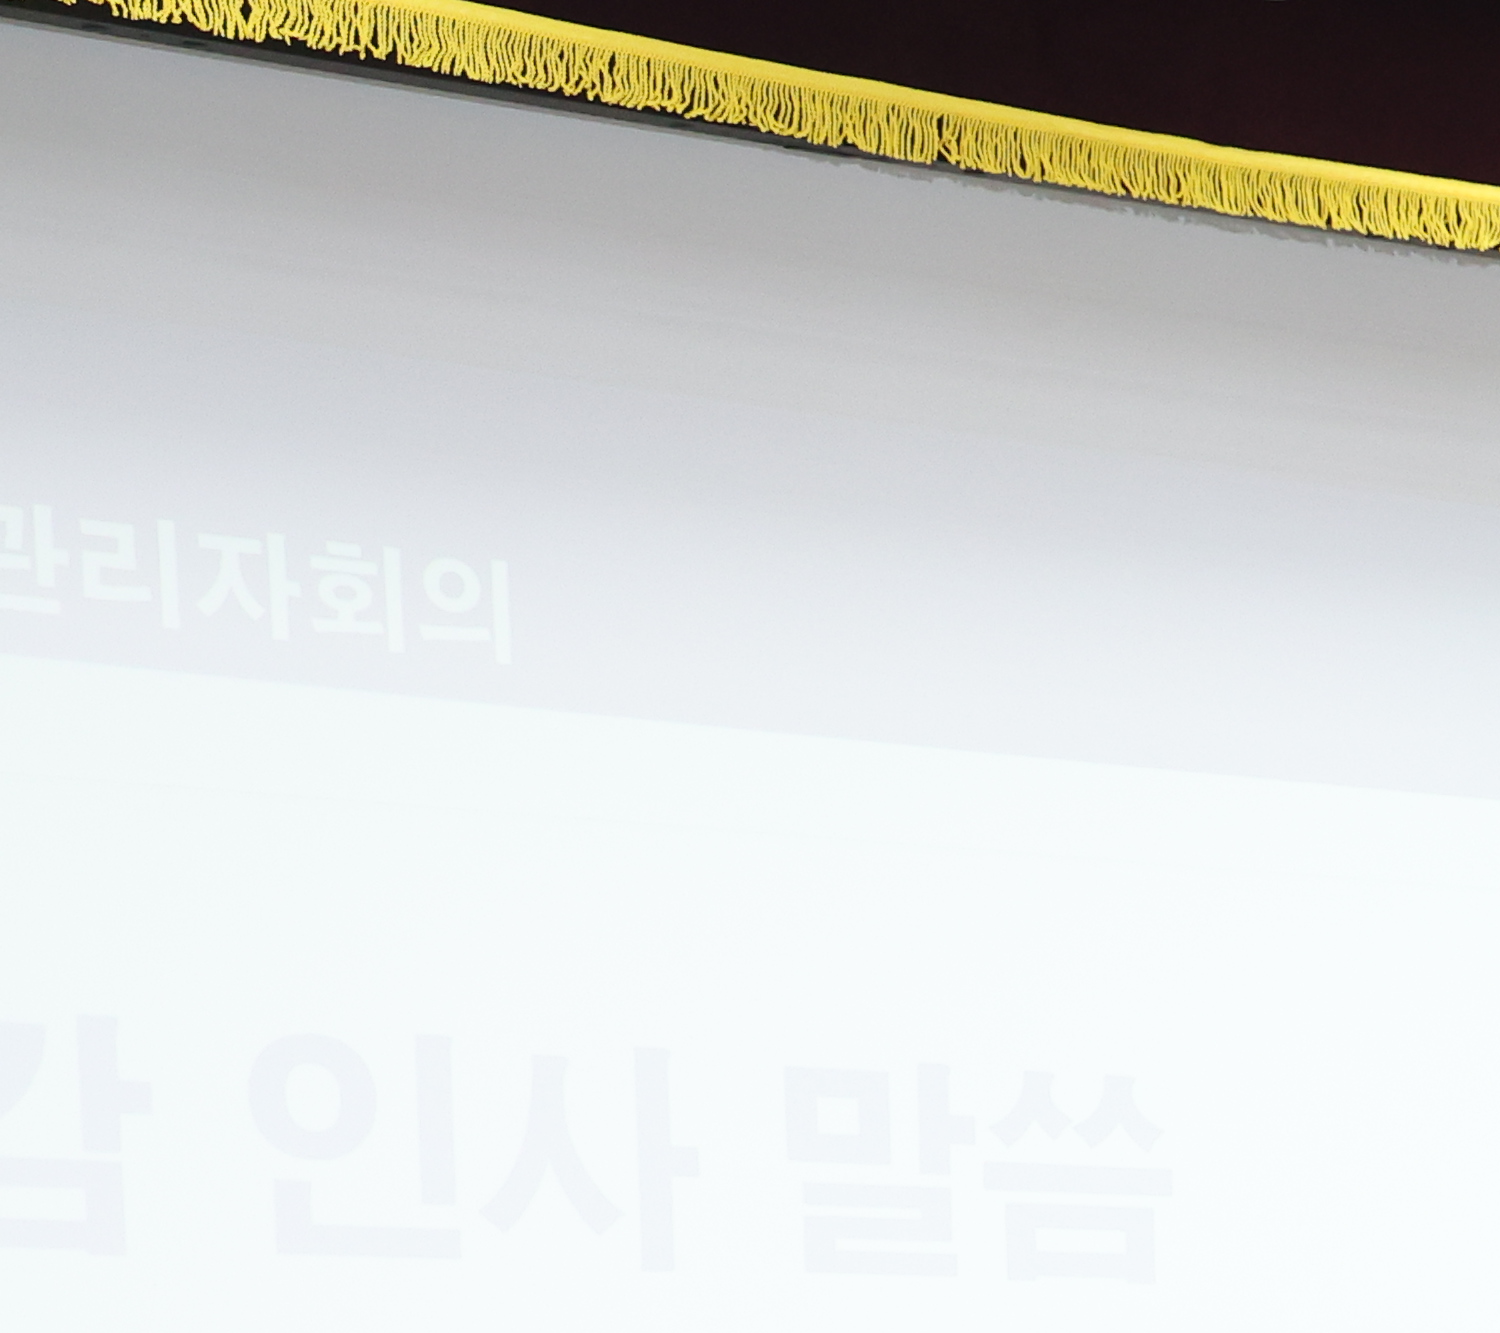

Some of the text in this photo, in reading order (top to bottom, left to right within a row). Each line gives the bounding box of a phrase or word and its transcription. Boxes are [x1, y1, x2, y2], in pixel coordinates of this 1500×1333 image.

[0, 503, 512, 666] 관리자회의
[247, 1032, 701, 1273] 인사
[783, 1062, 1174, 1285] 말씀
